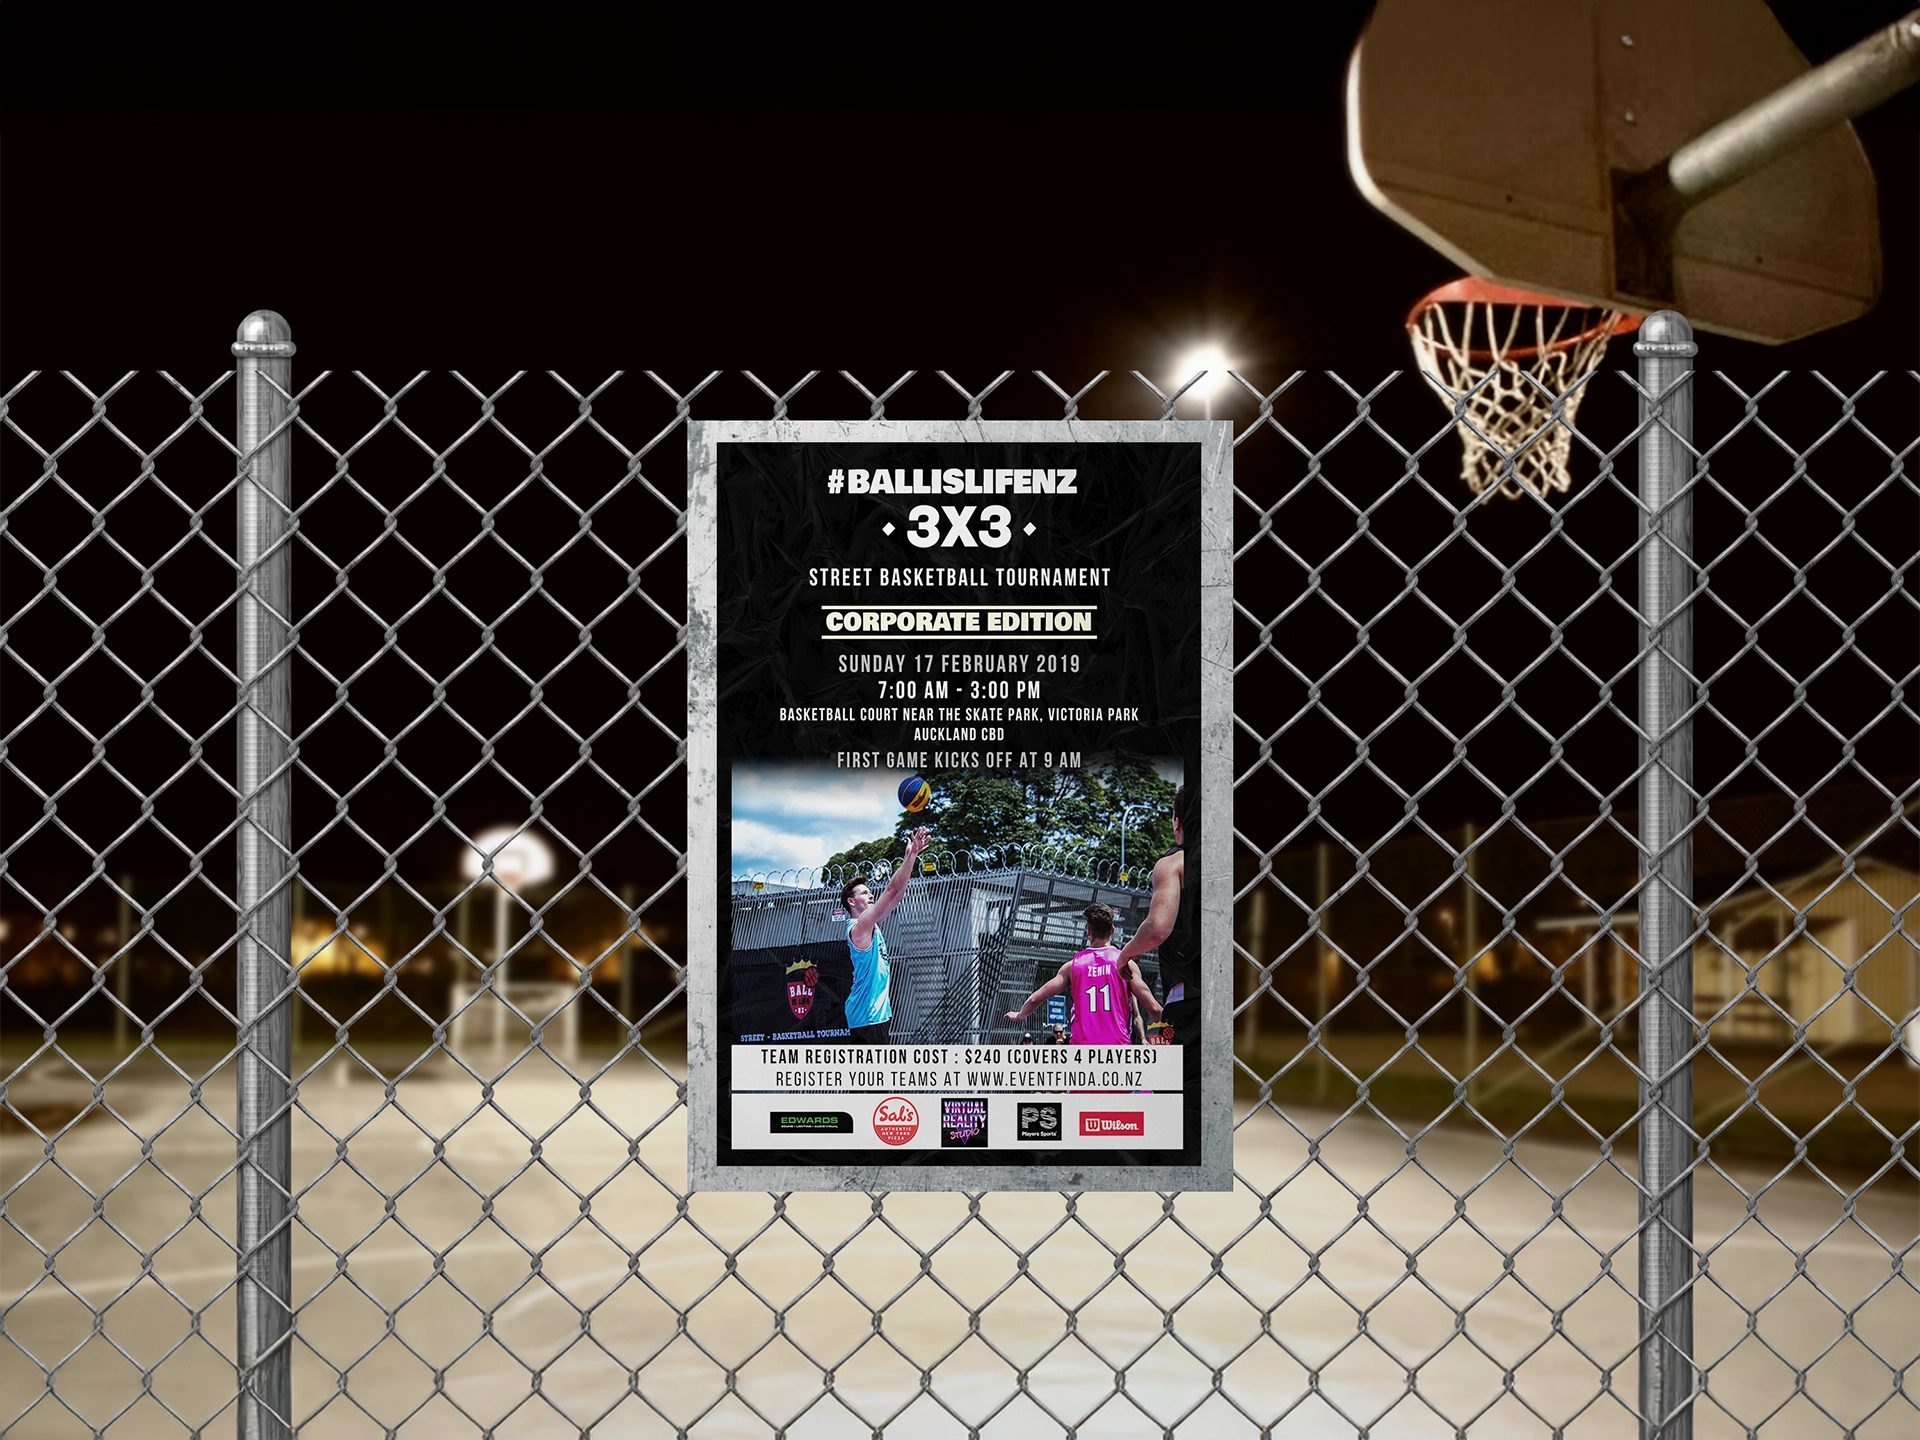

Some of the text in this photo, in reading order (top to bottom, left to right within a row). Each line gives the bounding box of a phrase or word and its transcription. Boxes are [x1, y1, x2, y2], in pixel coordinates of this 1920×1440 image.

[828, 468, 1077, 494] #BALLISLIFENZ
[907, 505, 1011, 548] 3X3
[810, 568, 1110, 586] STREET BASKETBALL TOURNAMENT
[826, 612, 1091, 631] CORPORATE EDITION
[839, 655, 1079, 672] SUNDAY 17 FEBRUARY 2019
[879, 681, 916, 699] 7:00
[924, 681, 947, 698] AM
[971, 681, 1008, 699] 3:00
[1018, 681, 1039, 698] PM
[780, 708, 1138, 722] BASKETBALL COURT NEAR THE SKATE PARK, VICTORIA PARK
[914, 728, 1004, 740] AUCKLAND CBD
[837, 751, 1081, 768] FIRST GAME KICKS OFF AT 9 AM
[1088, 964, 1111, 977] ZENIN
[1086, 983, 1111, 1013] 11
[741, 1034, 764, 1042] STREET
[772, 1031, 815, 1041] BASKETBALL
[761, 1049, 798, 1063] TEAM
[806, 1049, 906, 1064] REGISTRATION
[914, 1049, 948, 1064] COST
[965, 1049, 1001, 1065] $240
[1008, 1049, 1068, 1064] (COVERS
[1074, 1049, 1082, 1064] 4
[1089, 1049, 1157, 1064] PLAYERS)
[777, 1071, 1141, 1086] REGISTER YOUR TEAMS AT WWW.EVENTFINDA.CO.NZ
[879, 1105, 913, 1122] Sal's
[944, 1101, 986, 1114] VIRTUAL
[943, 1114, 986, 1128] REALITY
[1022, 1106, 1057, 1129] PS
[1101, 1120, 1138, 1130] Wilson
[950, 1128, 980, 1140] STUDIO
